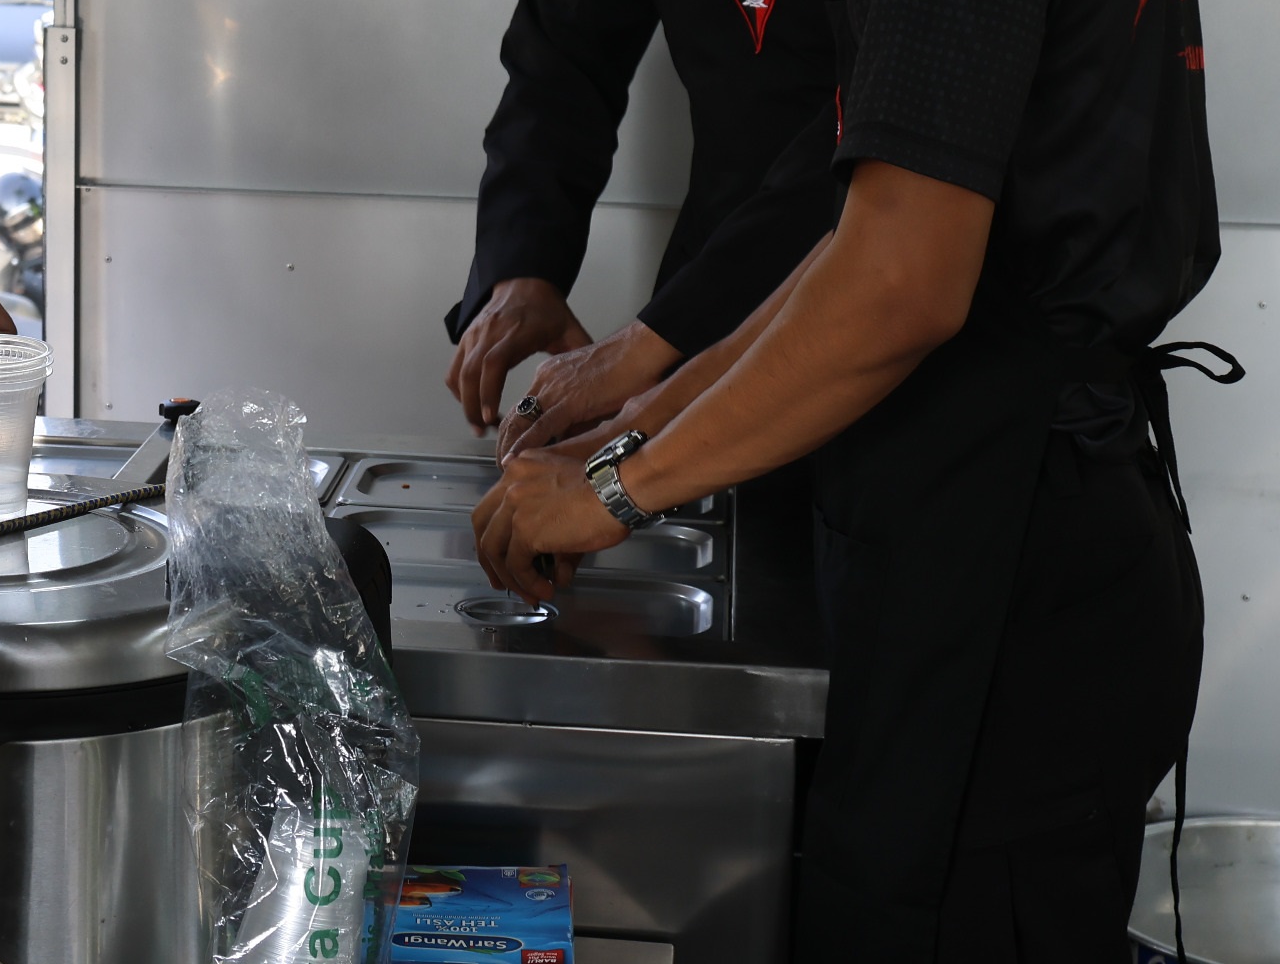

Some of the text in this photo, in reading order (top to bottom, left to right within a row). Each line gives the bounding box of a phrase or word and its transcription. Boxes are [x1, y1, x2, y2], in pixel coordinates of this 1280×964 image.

[304, 786, 352, 906] Cup
[416, 918, 499, 928] TEH ASLI
[436, 925, 478, 933] 100%
